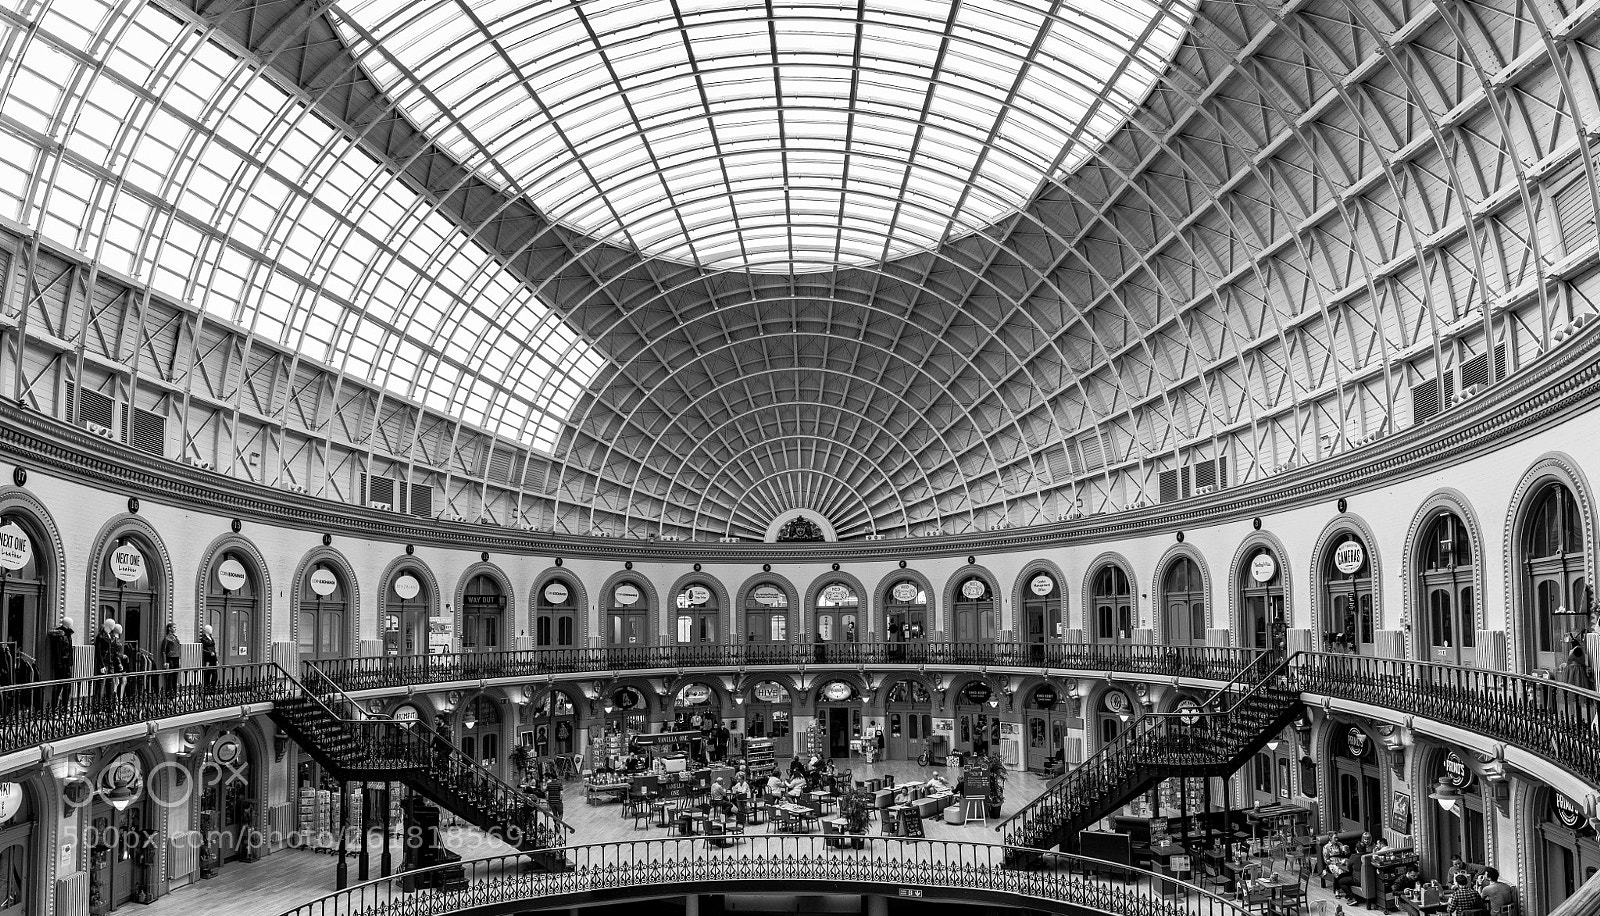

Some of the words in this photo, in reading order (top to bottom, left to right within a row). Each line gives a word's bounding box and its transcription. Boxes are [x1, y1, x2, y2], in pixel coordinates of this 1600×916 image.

[18, 467, 26, 481] 17
[132, 497, 138, 510] 16
[14, 537, 26, 552] ONE
[116, 552, 128, 564] NEXT
[130, 554, 140, 566] ONE
[1338, 549, 1360, 566] CAMERAS
[758, 689, 778, 697] HIVE
